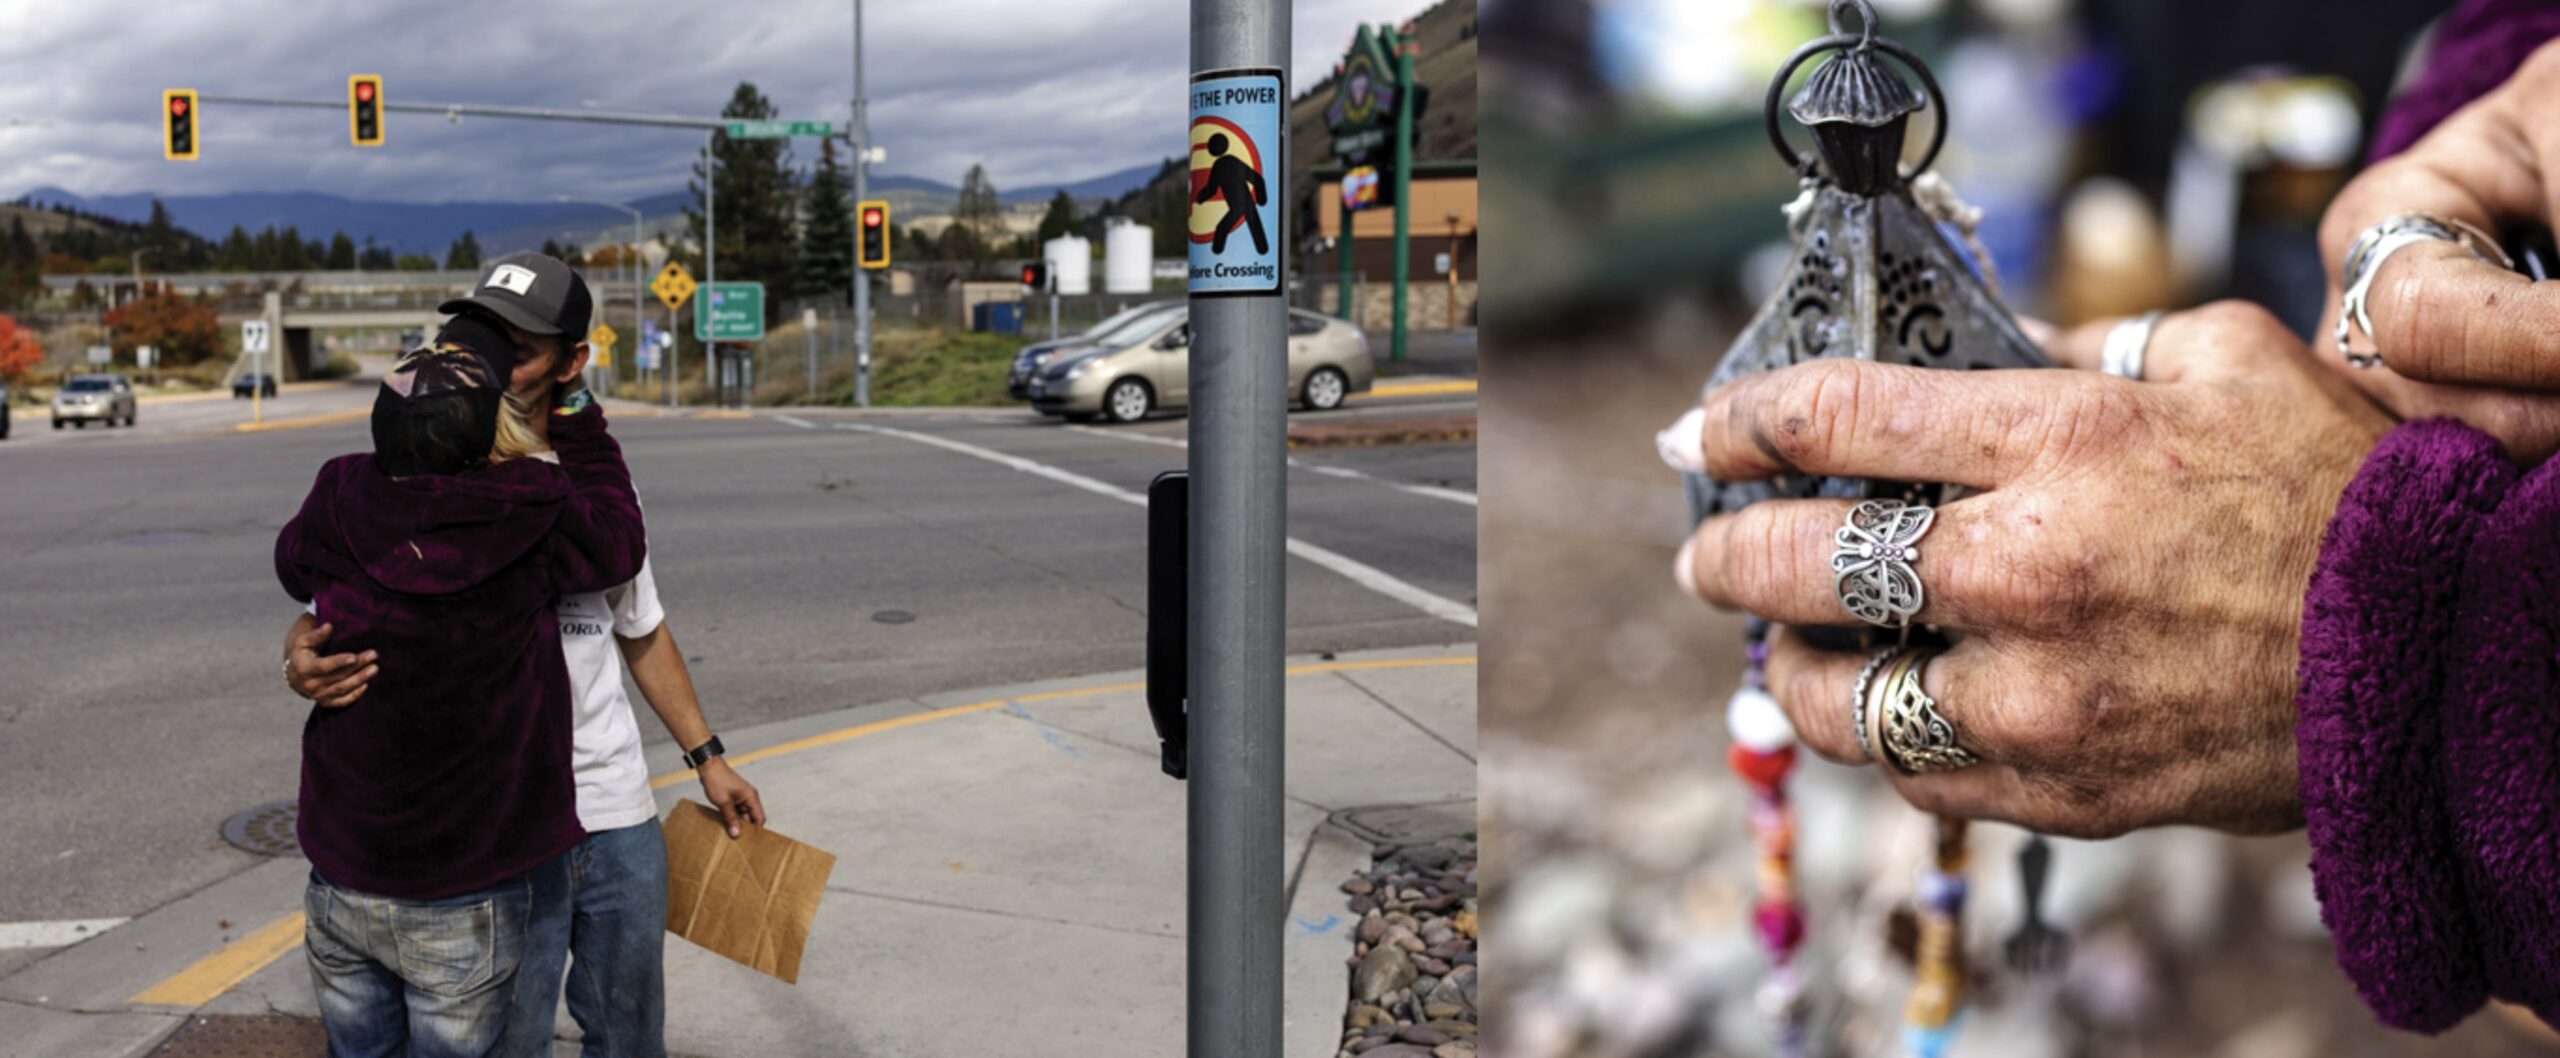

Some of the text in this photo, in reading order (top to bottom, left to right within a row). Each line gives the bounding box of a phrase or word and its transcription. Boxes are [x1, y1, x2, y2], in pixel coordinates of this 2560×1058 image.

[1200, 90, 1222, 108] THE
[1225, 87, 1276, 105] POWER
[1189, 261, 1275, 280] fore Crossing
[561, 622, 603, 636] ORIA
